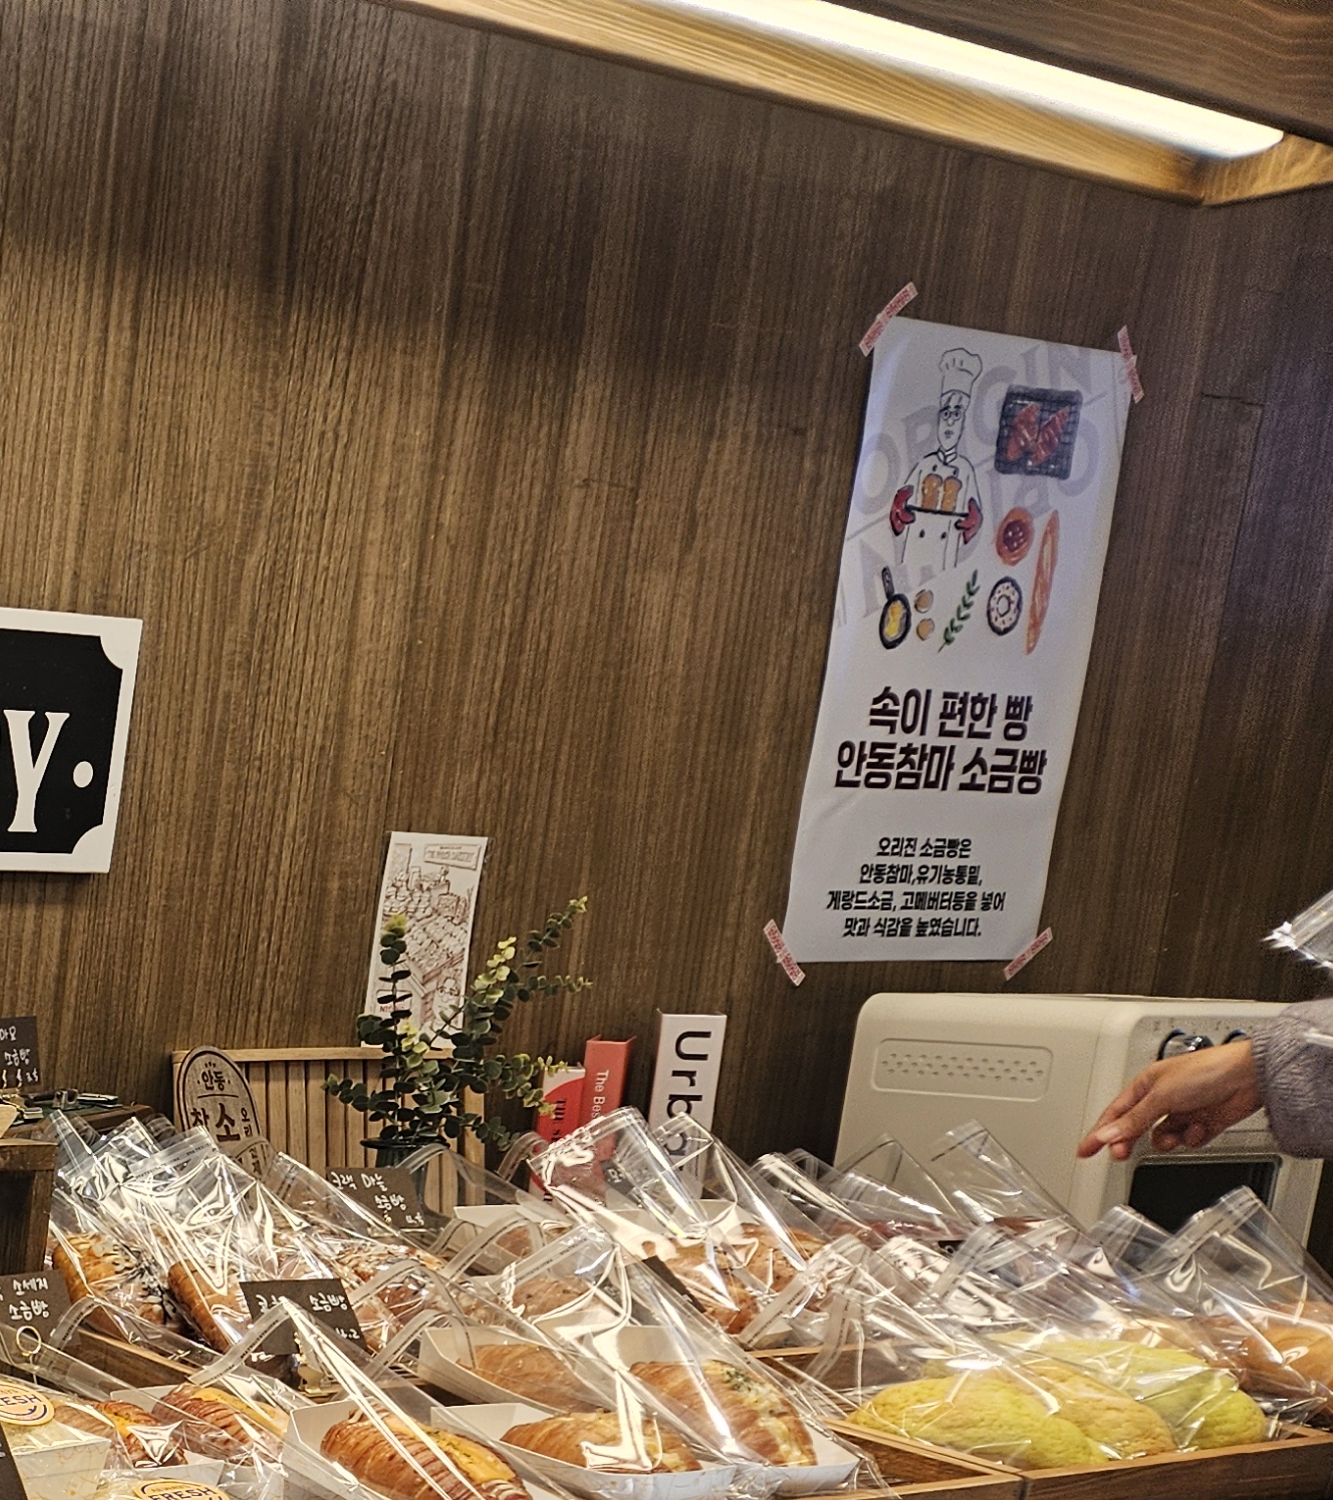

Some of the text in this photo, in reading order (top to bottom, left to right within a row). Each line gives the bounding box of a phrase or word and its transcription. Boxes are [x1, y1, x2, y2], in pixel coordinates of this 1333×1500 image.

[870, 686, 1033, 742] 속이 편한 빵
[835, 741, 1047, 795] 안동참마 소금빵
[876, 837, 972, 859] 오리진 소금빵은
[827, 891, 897, 912] 게랑드소금,
[843, 918, 982, 938] 맛과 식감을 높였습니다.
[200, 1068, 226, 1092] 안동
[593, 1068, 610, 1093] The
[8, 1299, 50, 1321] 소금빵
[309, 1290, 349, 1312] 소금빵
